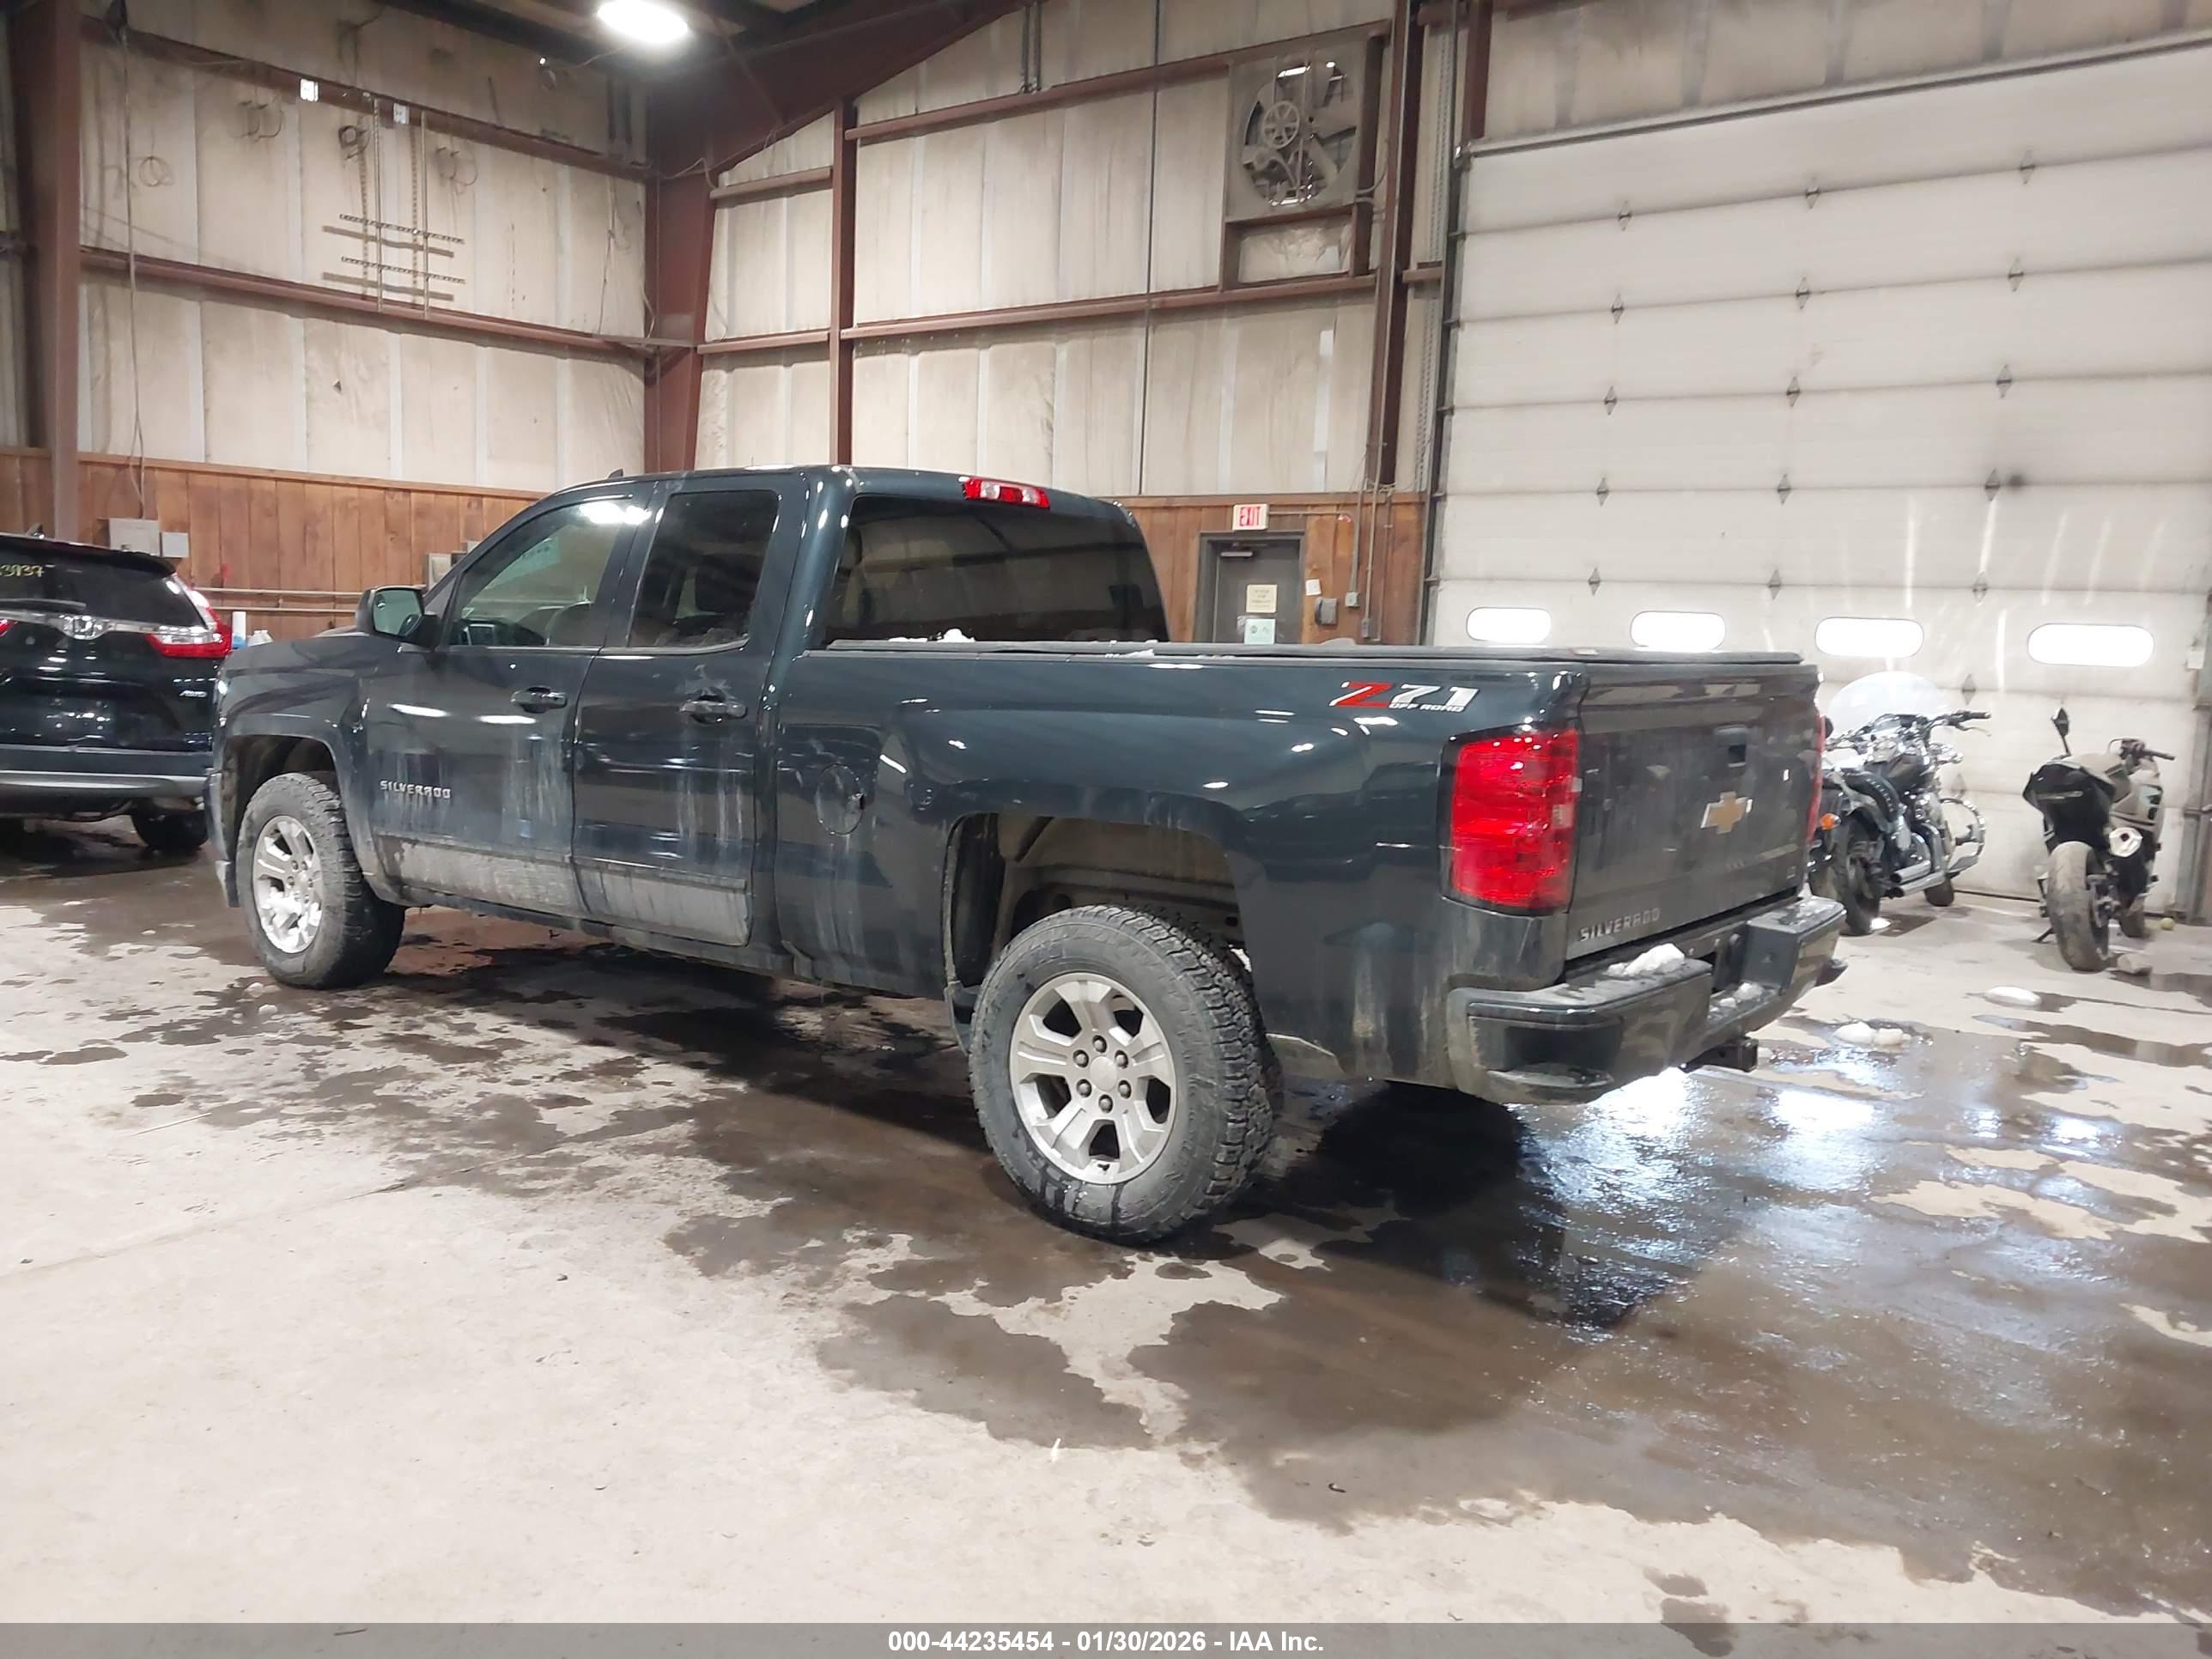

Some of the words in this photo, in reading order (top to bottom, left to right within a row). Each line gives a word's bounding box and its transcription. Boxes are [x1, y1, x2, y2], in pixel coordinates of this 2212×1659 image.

[1239, 507, 1261, 526] EXIT
[1328, 681, 1480, 708] Z71
[1419, 704, 1466, 713] ROAD
[380, 780, 452, 799] SILVERADO
[1580, 907, 1661, 942] SILVERADO
